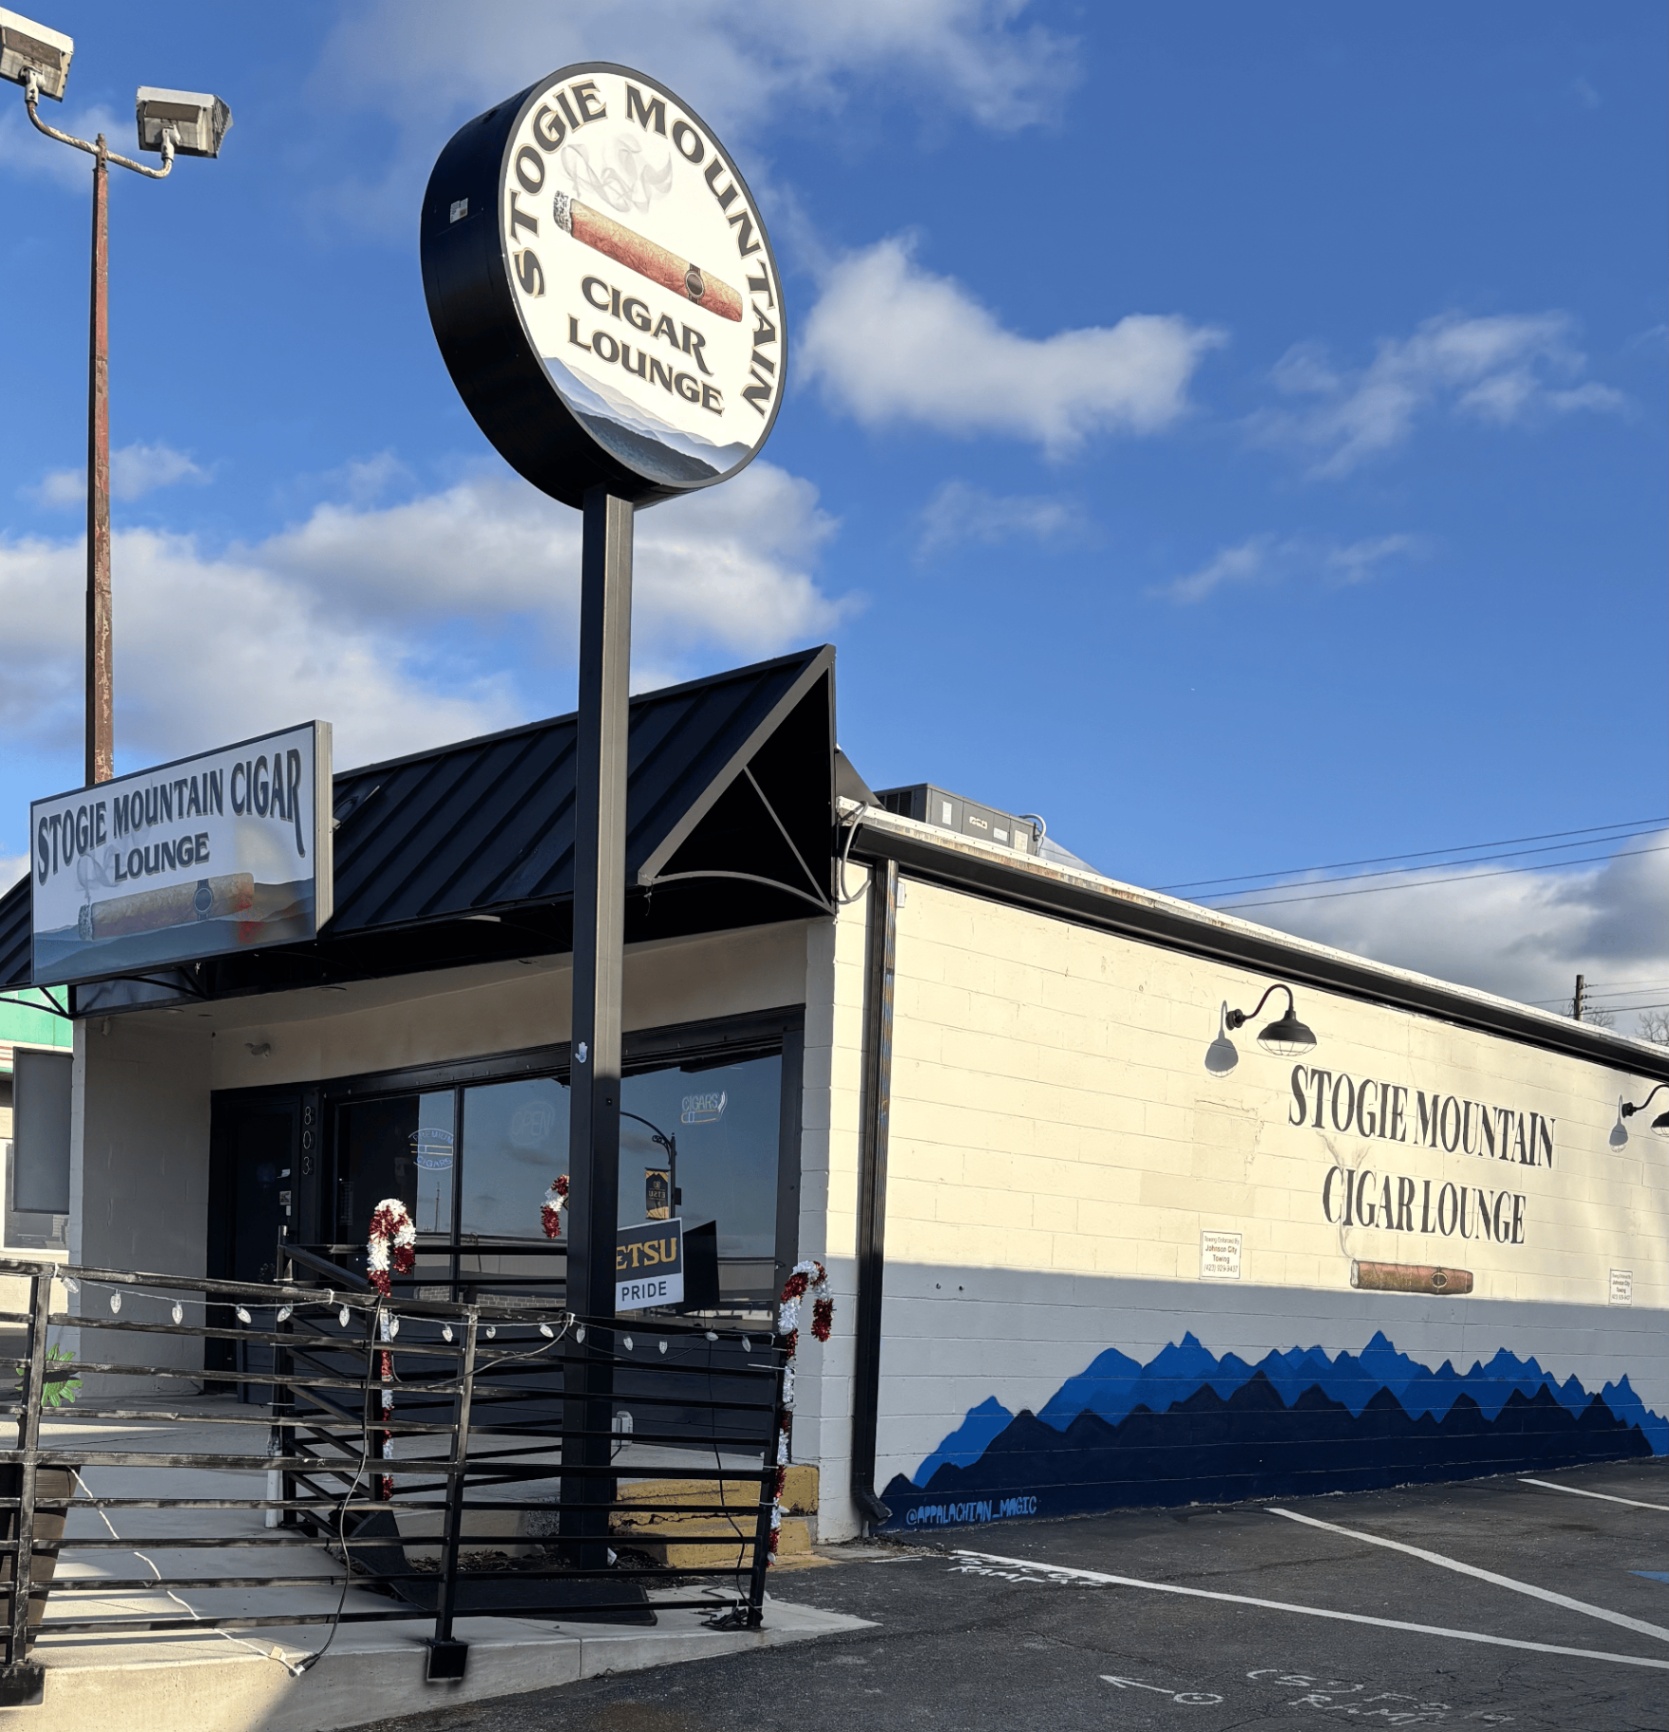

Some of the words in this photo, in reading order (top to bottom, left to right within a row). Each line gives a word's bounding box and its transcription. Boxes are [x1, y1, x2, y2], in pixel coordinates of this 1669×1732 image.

[509, 79, 607, 299] STOGIE
[624, 81, 778, 419] MOUNTAIN
[581, 275, 714, 375] CIGAR
[566, 313, 725, 418] LOUNGE
[37, 801, 108, 887] STOGIE
[113, 768, 224, 839] MOUNTAIN
[230, 748, 306, 858] CIGAR
[114, 832, 211, 882] LOUNGE
[682, 1092, 718, 1111] CIGARS
[1288, 1063, 1408, 1144] STOGIE
[1413, 1090, 1556, 1169] MOUNTAIN
[303, 1105, 315, 1176] 803
[416, 1155, 453, 1168] CIGARS
[1322, 1164, 1415, 1232] CIGAR
[1420, 1180, 1527, 1245] LOUNGE
[616, 1237, 677, 1271] ETSU
[1213, 1254, 1230, 1264] Towing
[1228, 1246, 1237, 1255] City
[621, 1280, 667, 1301] PRIDE
